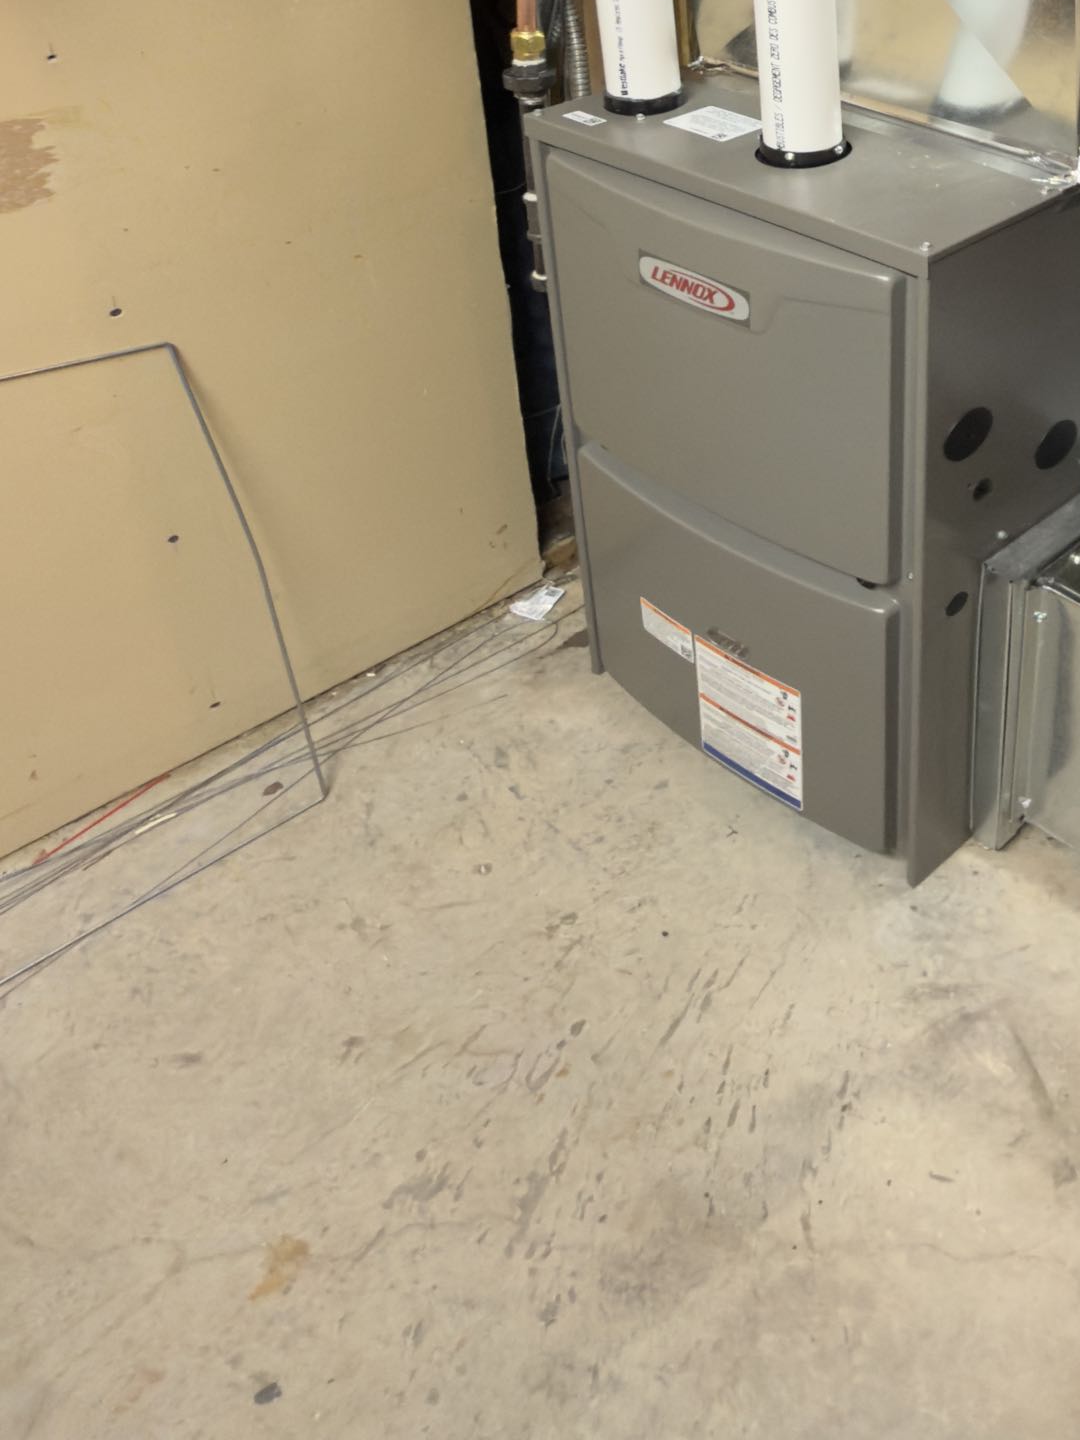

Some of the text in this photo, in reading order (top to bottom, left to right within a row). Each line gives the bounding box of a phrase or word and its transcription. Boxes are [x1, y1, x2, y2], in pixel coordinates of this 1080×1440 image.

[767, 28, 779, 41] DES
[769, 43, 781, 61] ZERO
[650, 265, 719, 304] LENNOX
